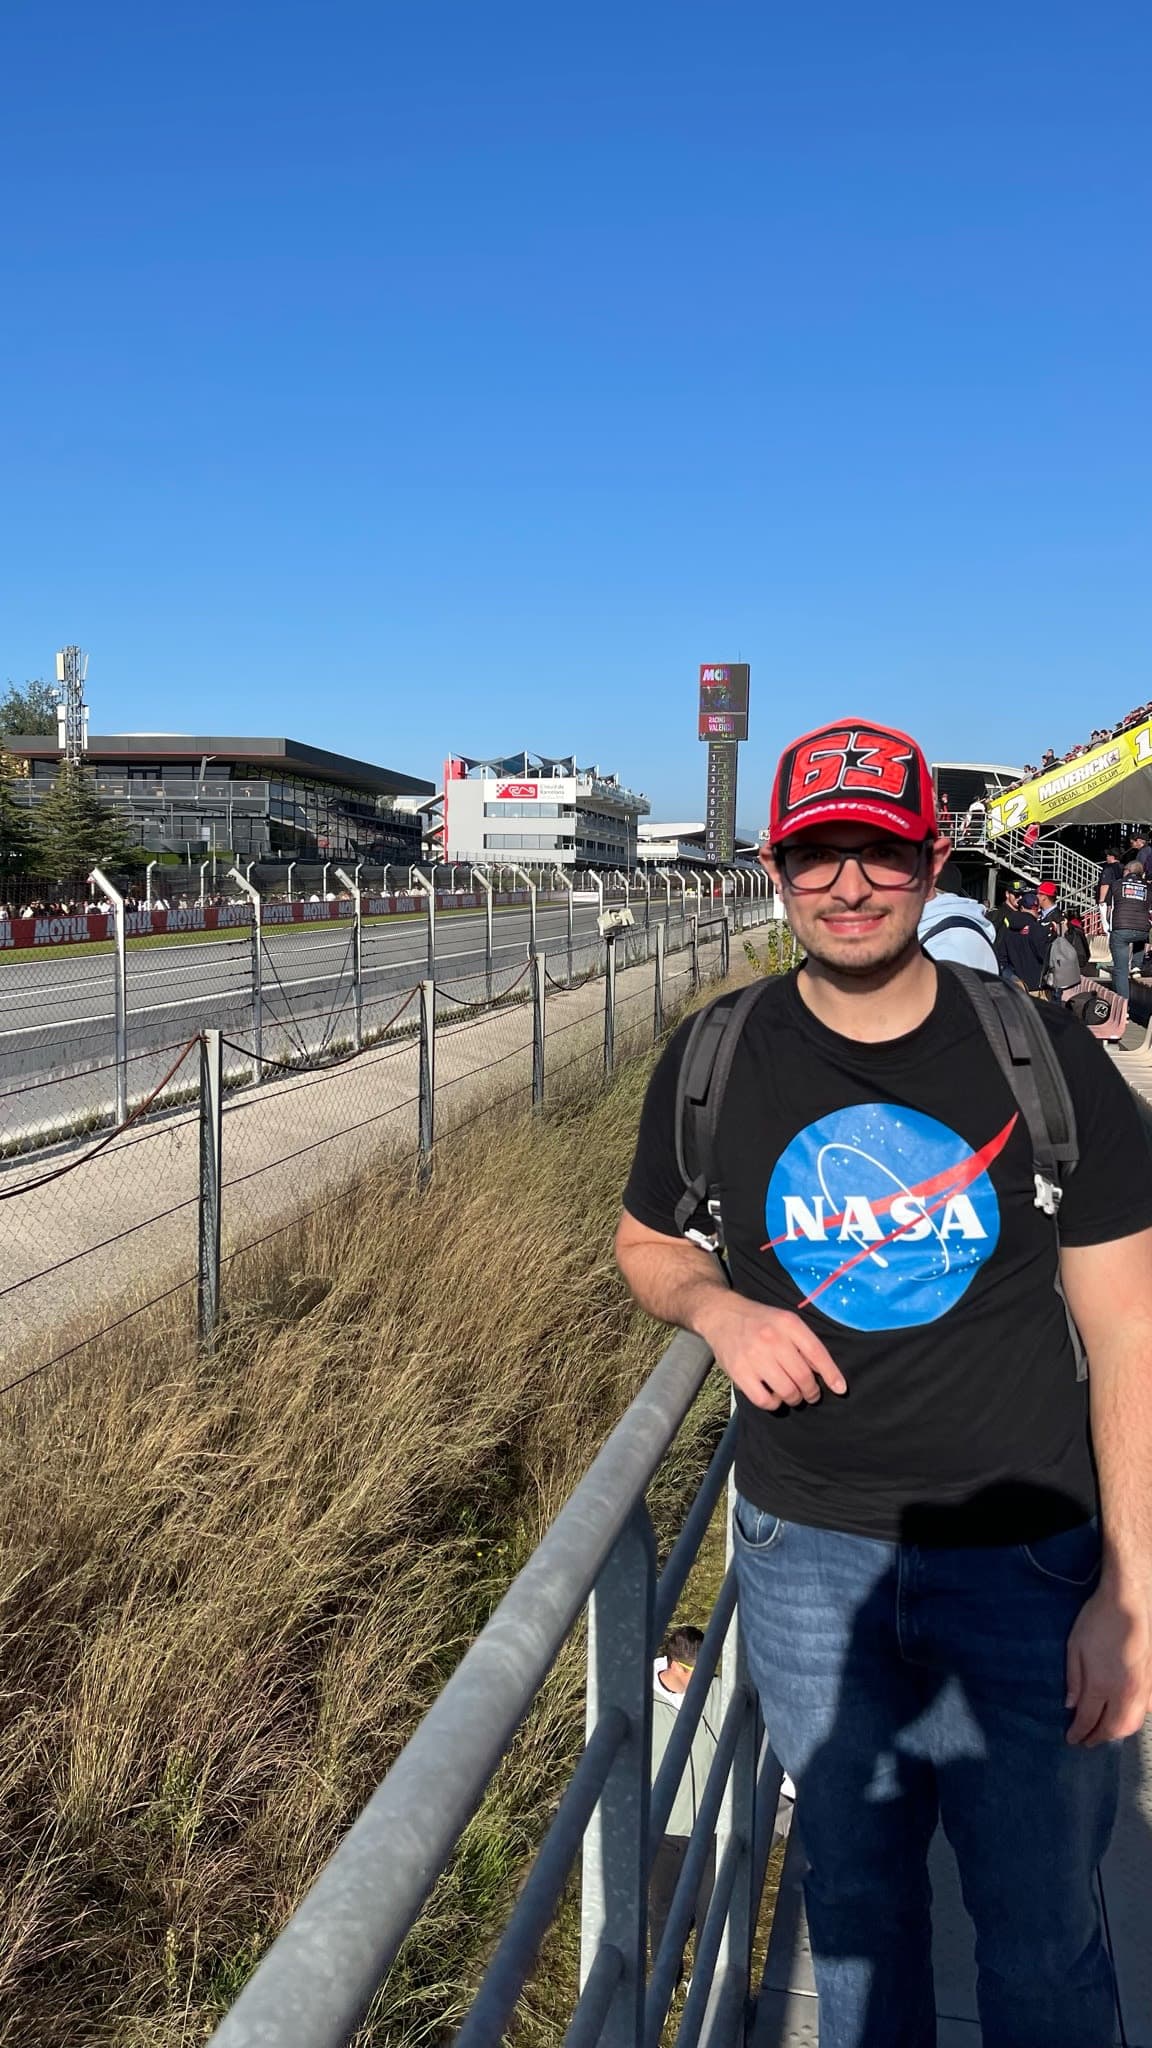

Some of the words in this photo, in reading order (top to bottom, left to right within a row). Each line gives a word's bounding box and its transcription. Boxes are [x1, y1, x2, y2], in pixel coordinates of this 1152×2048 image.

[788, 731, 913, 810] 63
[1039, 754, 1109, 802] MAVERICK
[1048, 790, 1080, 808] OFFICIAL
[1083, 779, 1097, 792] FAN
[33, 917, 90, 944] MOTUL
[166, 909, 206, 931] MOTUL
[782, 1195, 988, 1242] NASA
